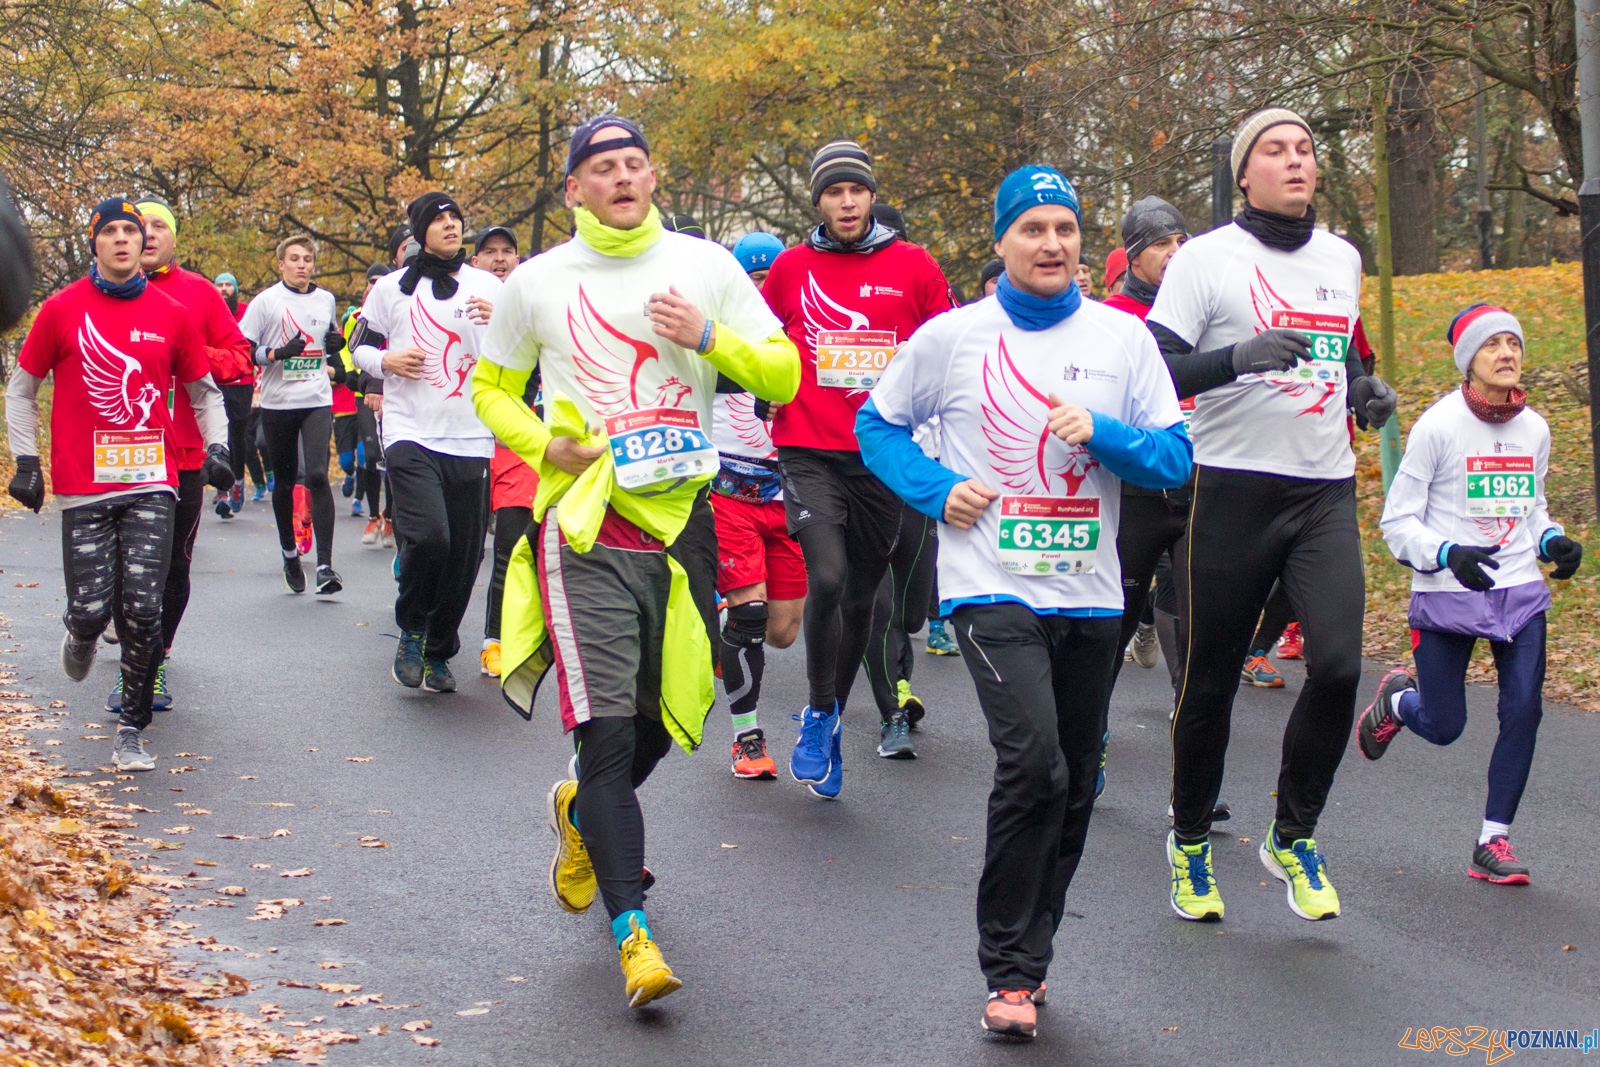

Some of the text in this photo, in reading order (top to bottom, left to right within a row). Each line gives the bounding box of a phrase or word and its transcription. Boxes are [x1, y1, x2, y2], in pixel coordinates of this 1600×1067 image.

[1315, 320, 1346, 330] RunPoland.org
[289, 359, 318, 370] 7044
[828, 350, 888, 369] 7320
[659, 416, 695, 425] RunPoland.org
[614, 428, 701, 460] E 8281
[105, 447, 158, 465] 5185
[656, 456, 675, 465] Marek
[1469, 476, 1530, 496] C 1962
[1057, 506, 1094, 514] RunPoland.org
[1001, 522, 1090, 549] C 6345
